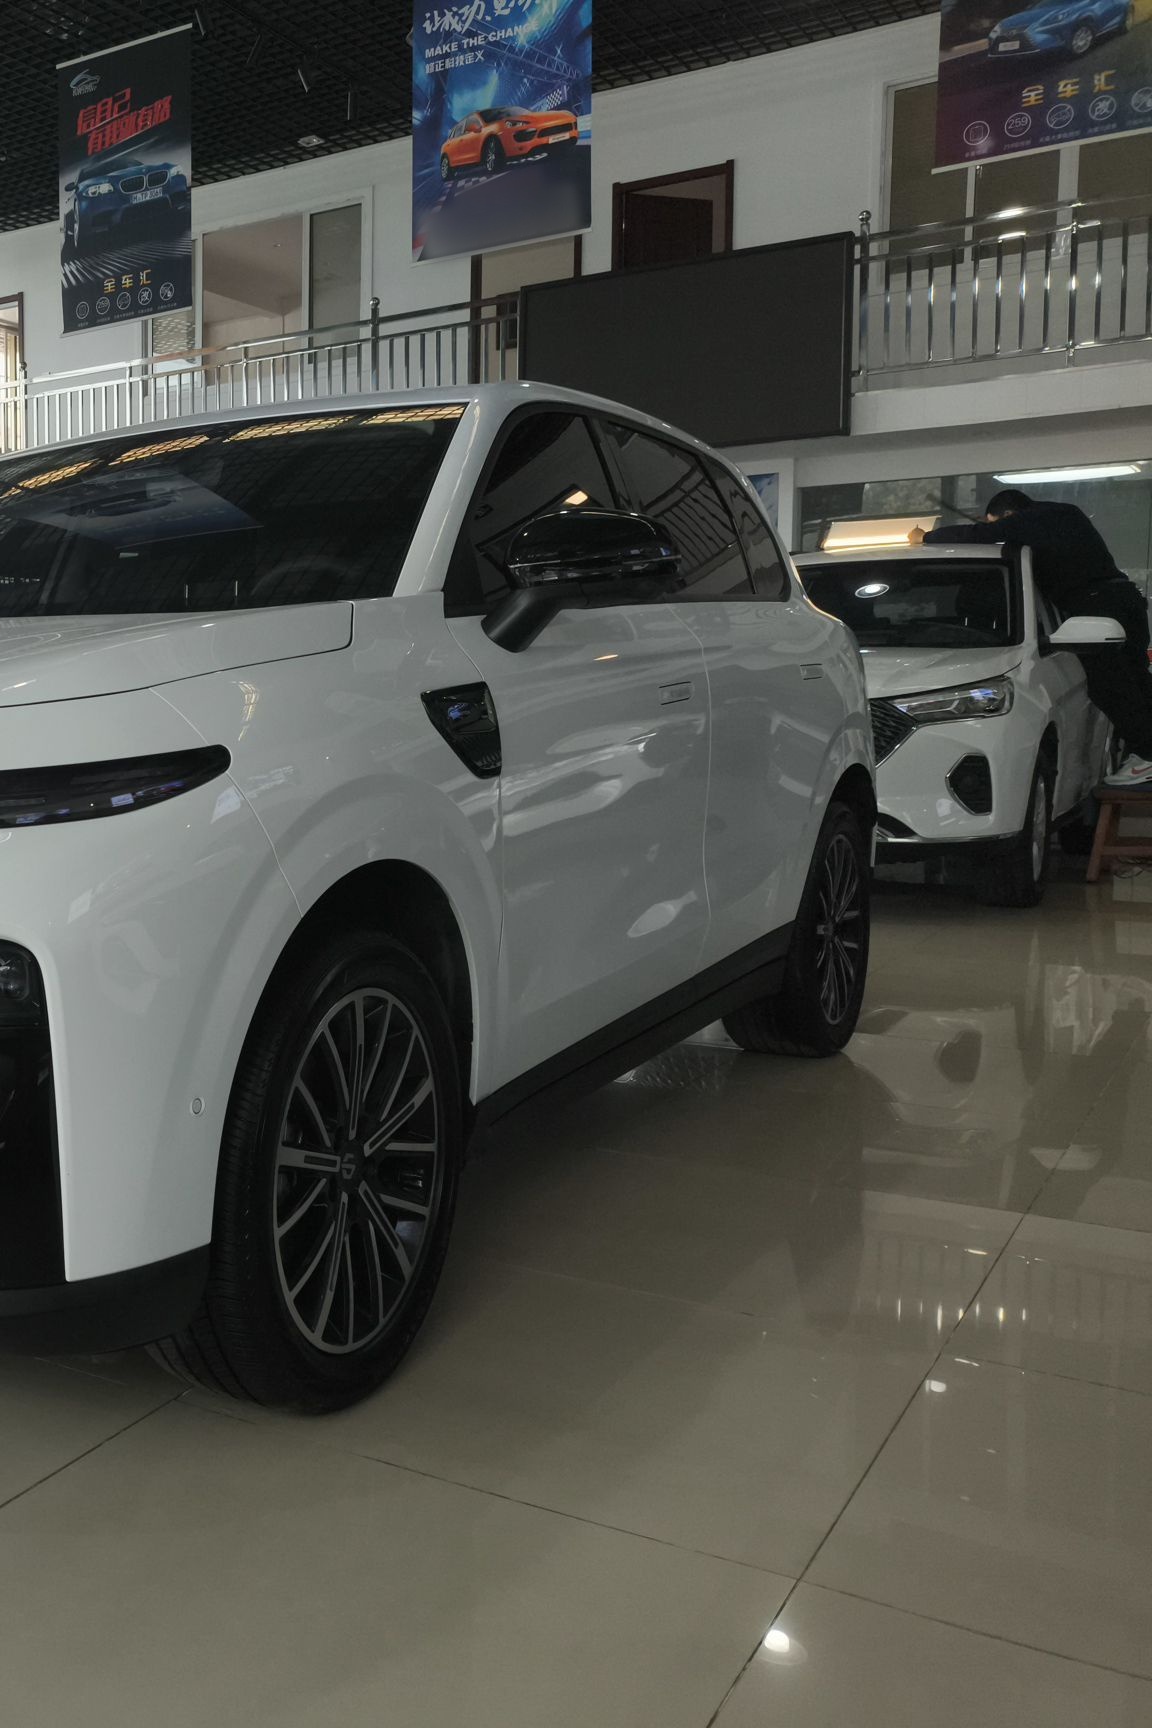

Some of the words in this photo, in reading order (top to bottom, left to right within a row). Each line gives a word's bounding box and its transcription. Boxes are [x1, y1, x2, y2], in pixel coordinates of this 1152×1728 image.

[425, 41, 459, 59] MAKE
[463, 35, 485, 50] THE
[488, 22, 540, 42] CHANGE
[1021, 69, 1117, 108] 全车汇
[103, 269, 152, 294] 全车汇
